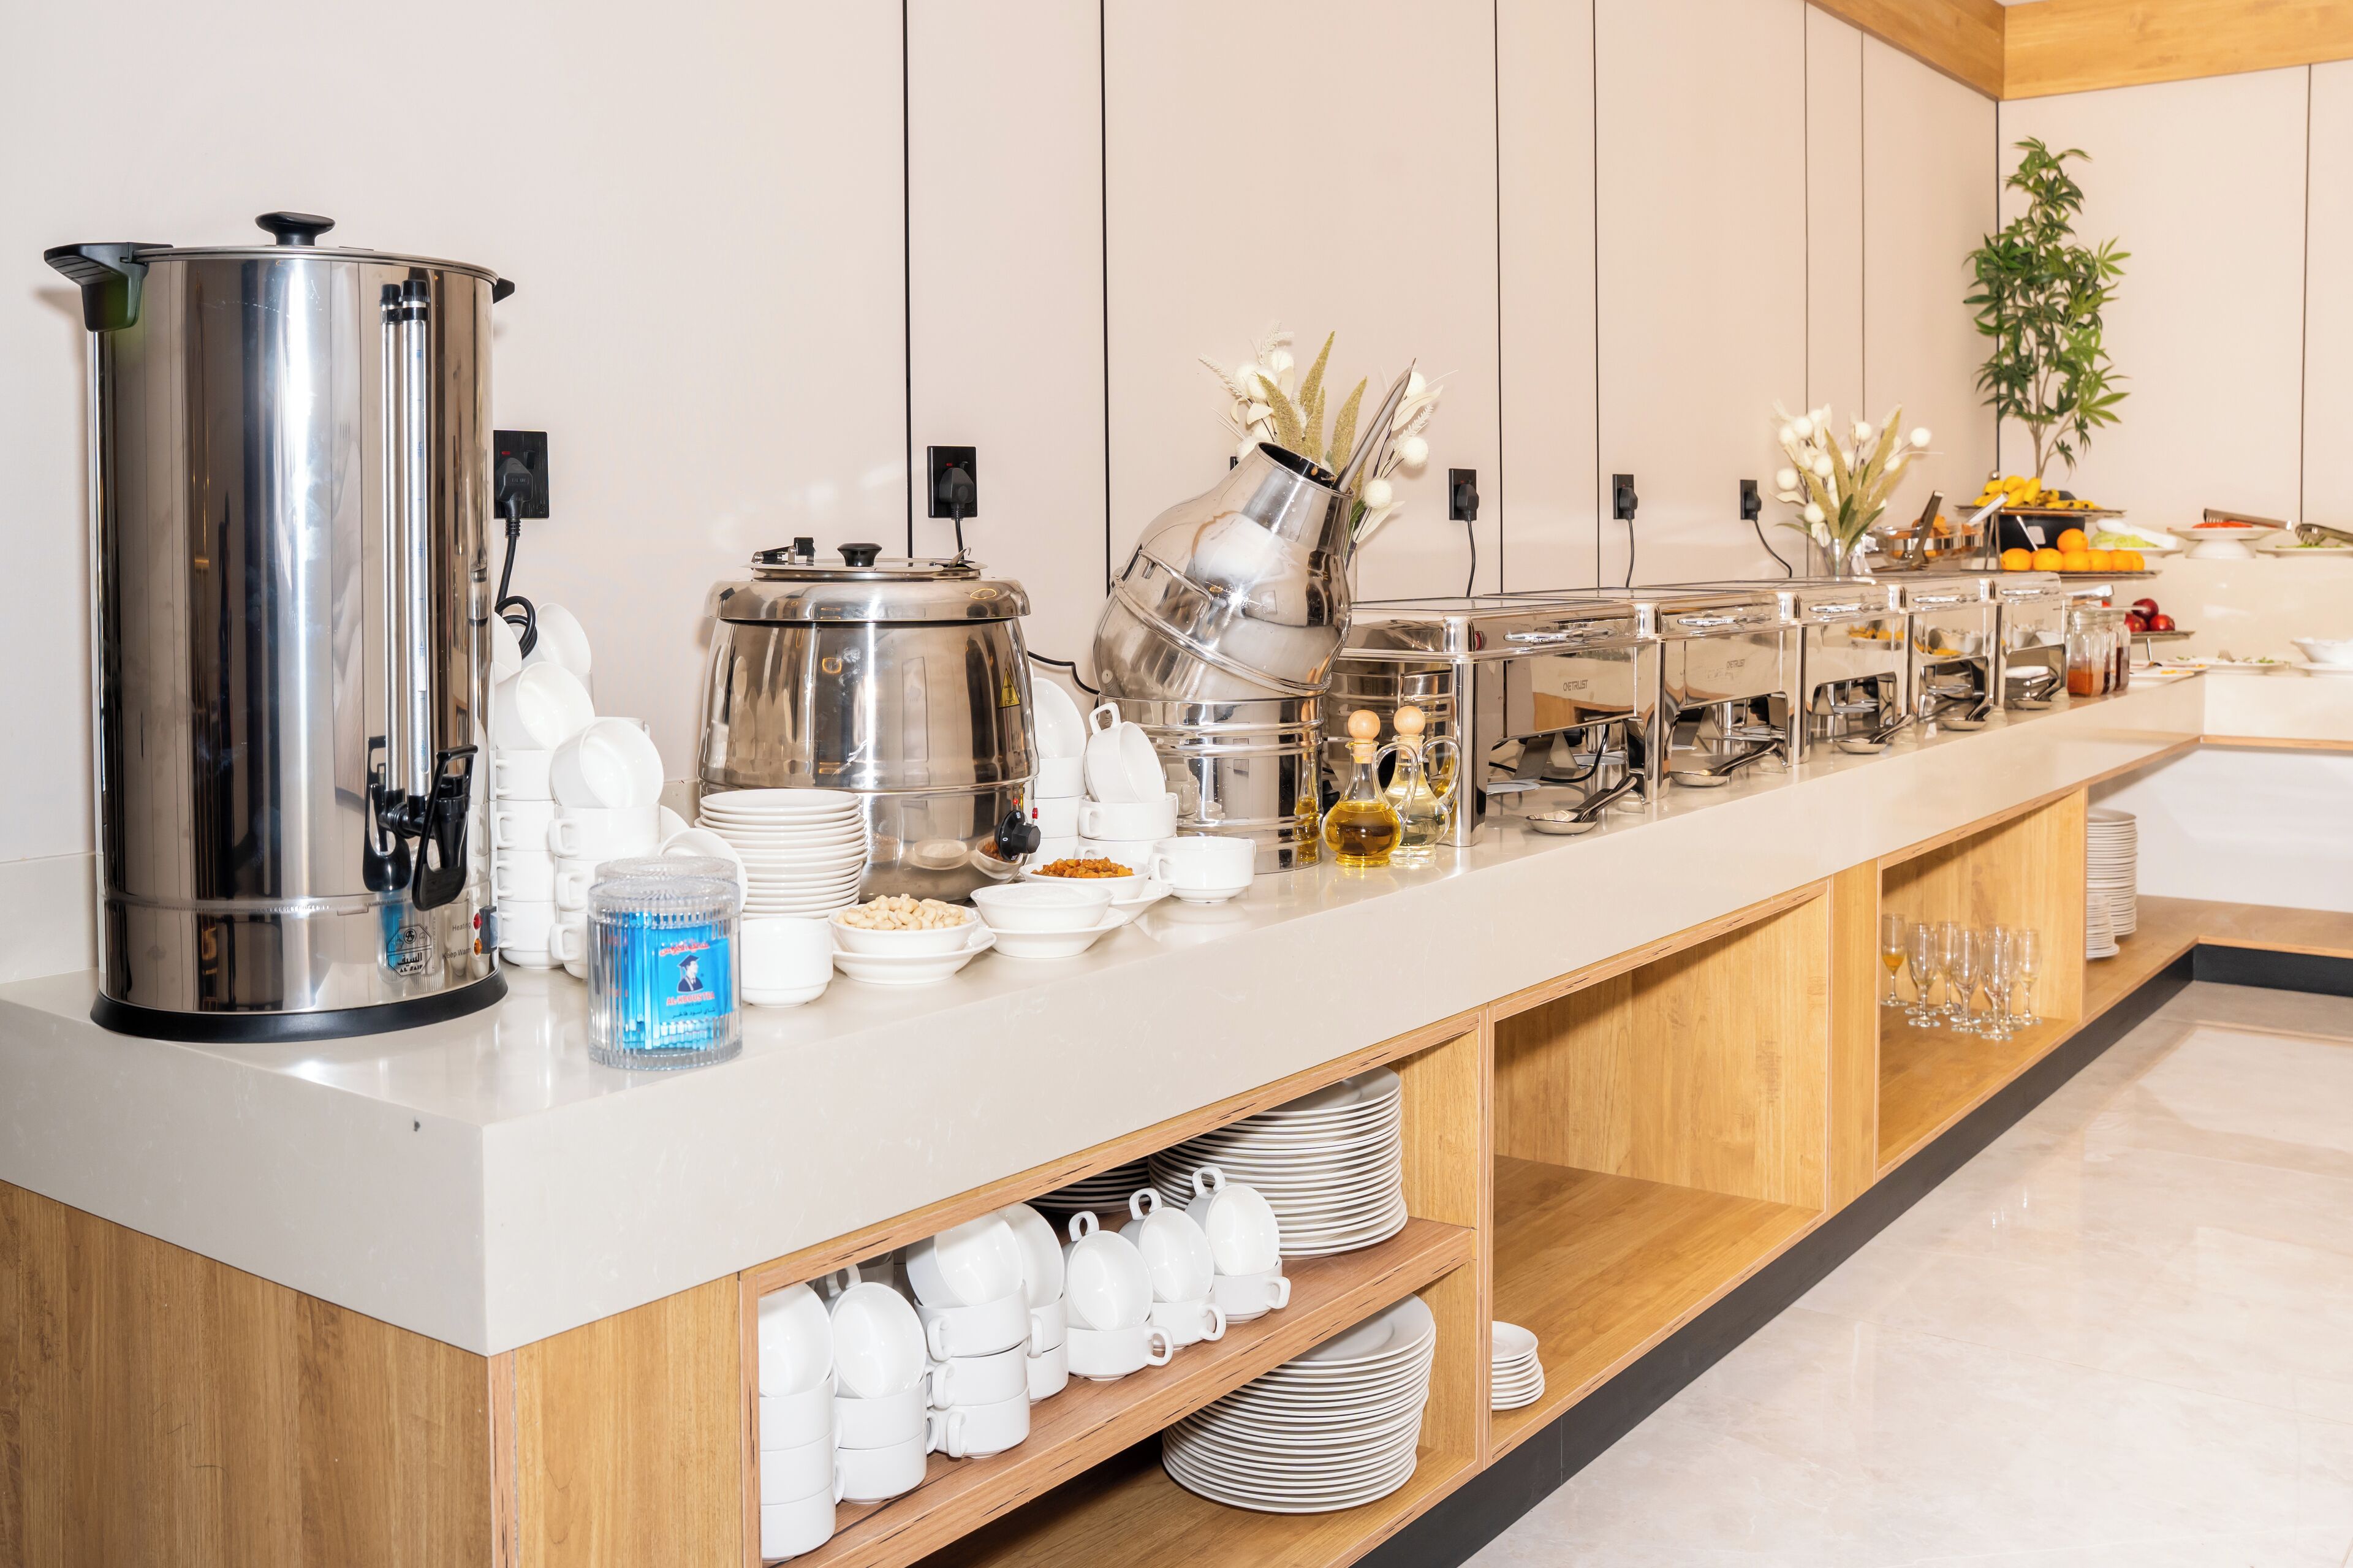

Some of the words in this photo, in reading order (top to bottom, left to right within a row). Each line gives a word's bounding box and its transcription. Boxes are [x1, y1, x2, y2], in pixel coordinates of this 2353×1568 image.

[452, 922, 471, 931] Heating
[397, 952, 422, 966] السيف
[442, 951, 457, 960] Keep
[703, 991, 714, 1001] TEA
